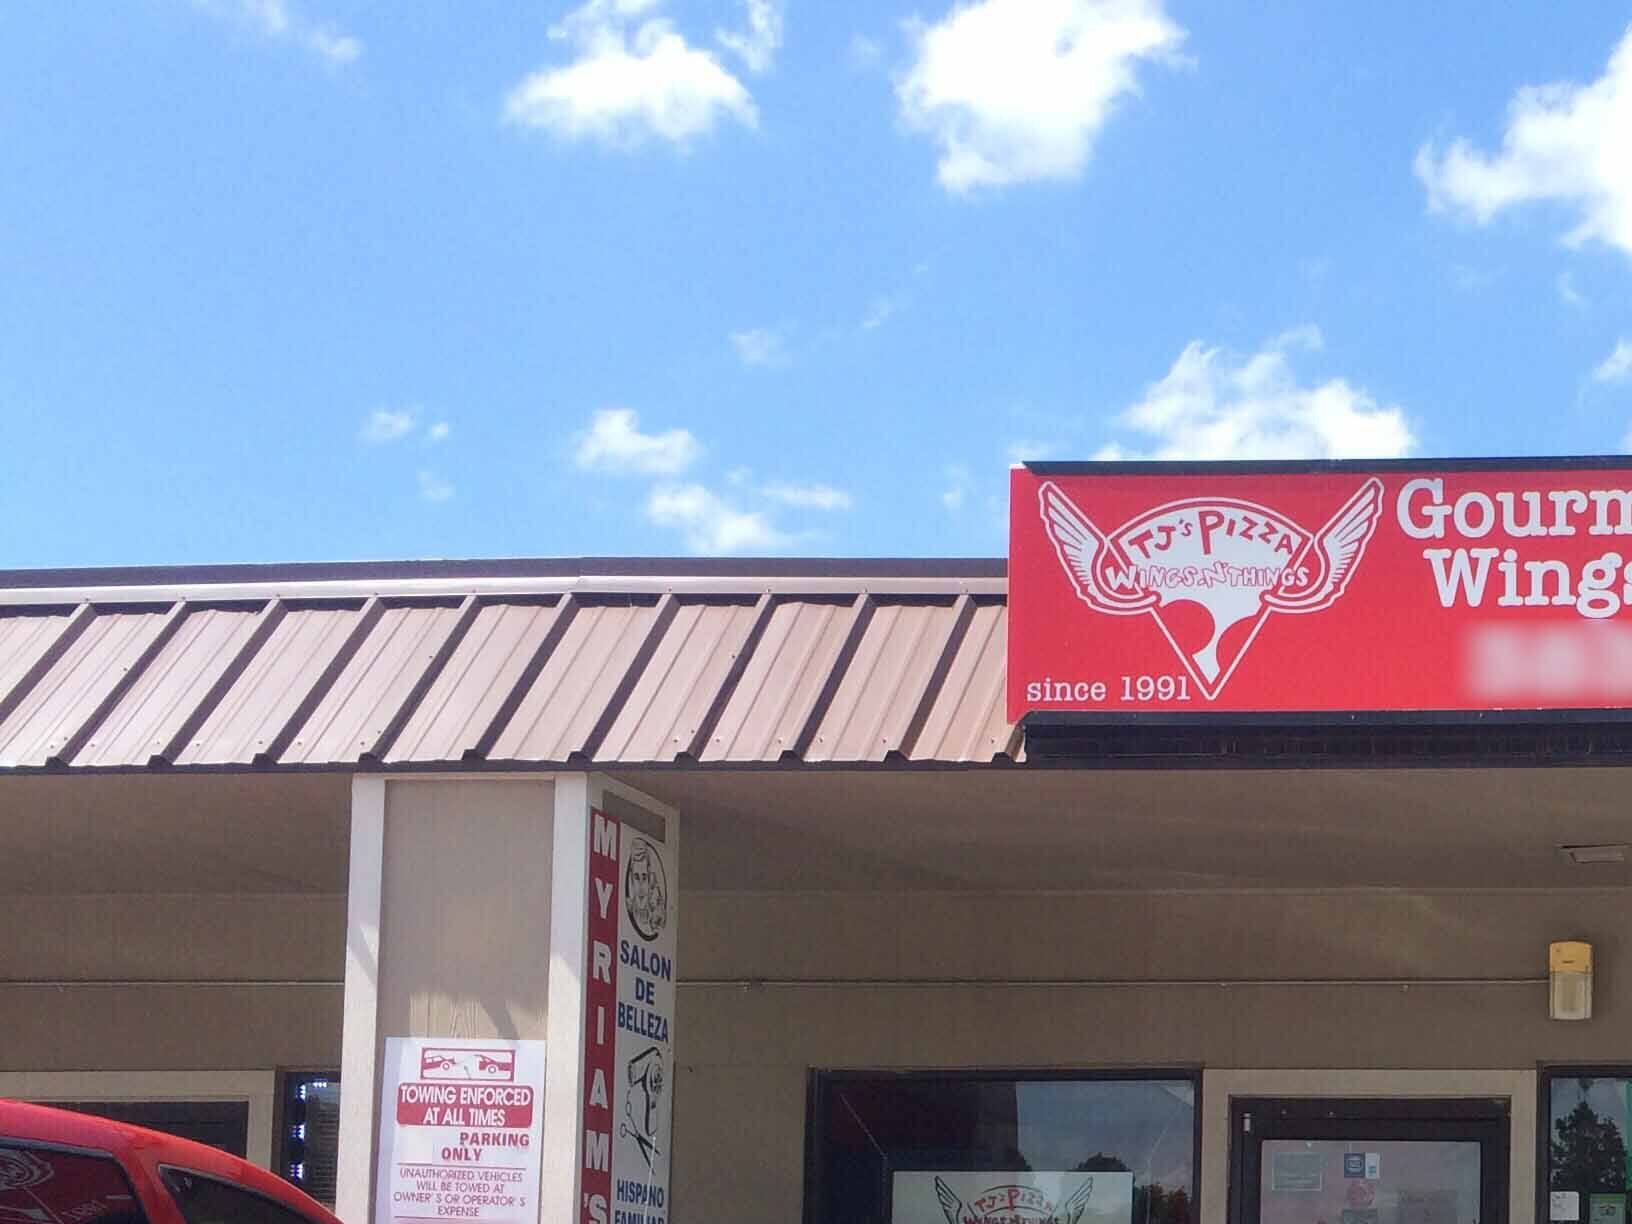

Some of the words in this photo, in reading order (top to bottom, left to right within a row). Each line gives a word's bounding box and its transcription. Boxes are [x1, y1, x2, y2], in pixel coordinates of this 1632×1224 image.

[1026, 677, 1106, 702] since
[1120, 676, 1191, 701] 1991
[620, 940, 671, 982] SALON
[635, 977, 655, 1005] DE
[618, 1002, 668, 1043] BELLEZA
[400, 1085, 457, 1104] TOWING
[460, 1087, 531, 1106] ENFORCED
[423, 1107, 440, 1124] AT
[442, 1107, 465, 1125] ALL
[468, 1108, 506, 1126] TIMES
[459, 1132, 530, 1146] PARKING
[441, 1147, 482, 1161] ONLY
[400, 1167, 474, 1181] UNAUTHORIZED
[477, 1171, 523, 1183] VEHICLES
[416, 1180, 437, 1191] WILL
[440, 1182, 452, 1192] BE
[455, 1182, 490, 1193] TOWED
[493, 1183, 505, 1194] AT
[617, 1179, 664, 1209] HISPANO
[444, 1194, 460, 1204] OR
[437, 1206, 480, 1217] EXPENSE
